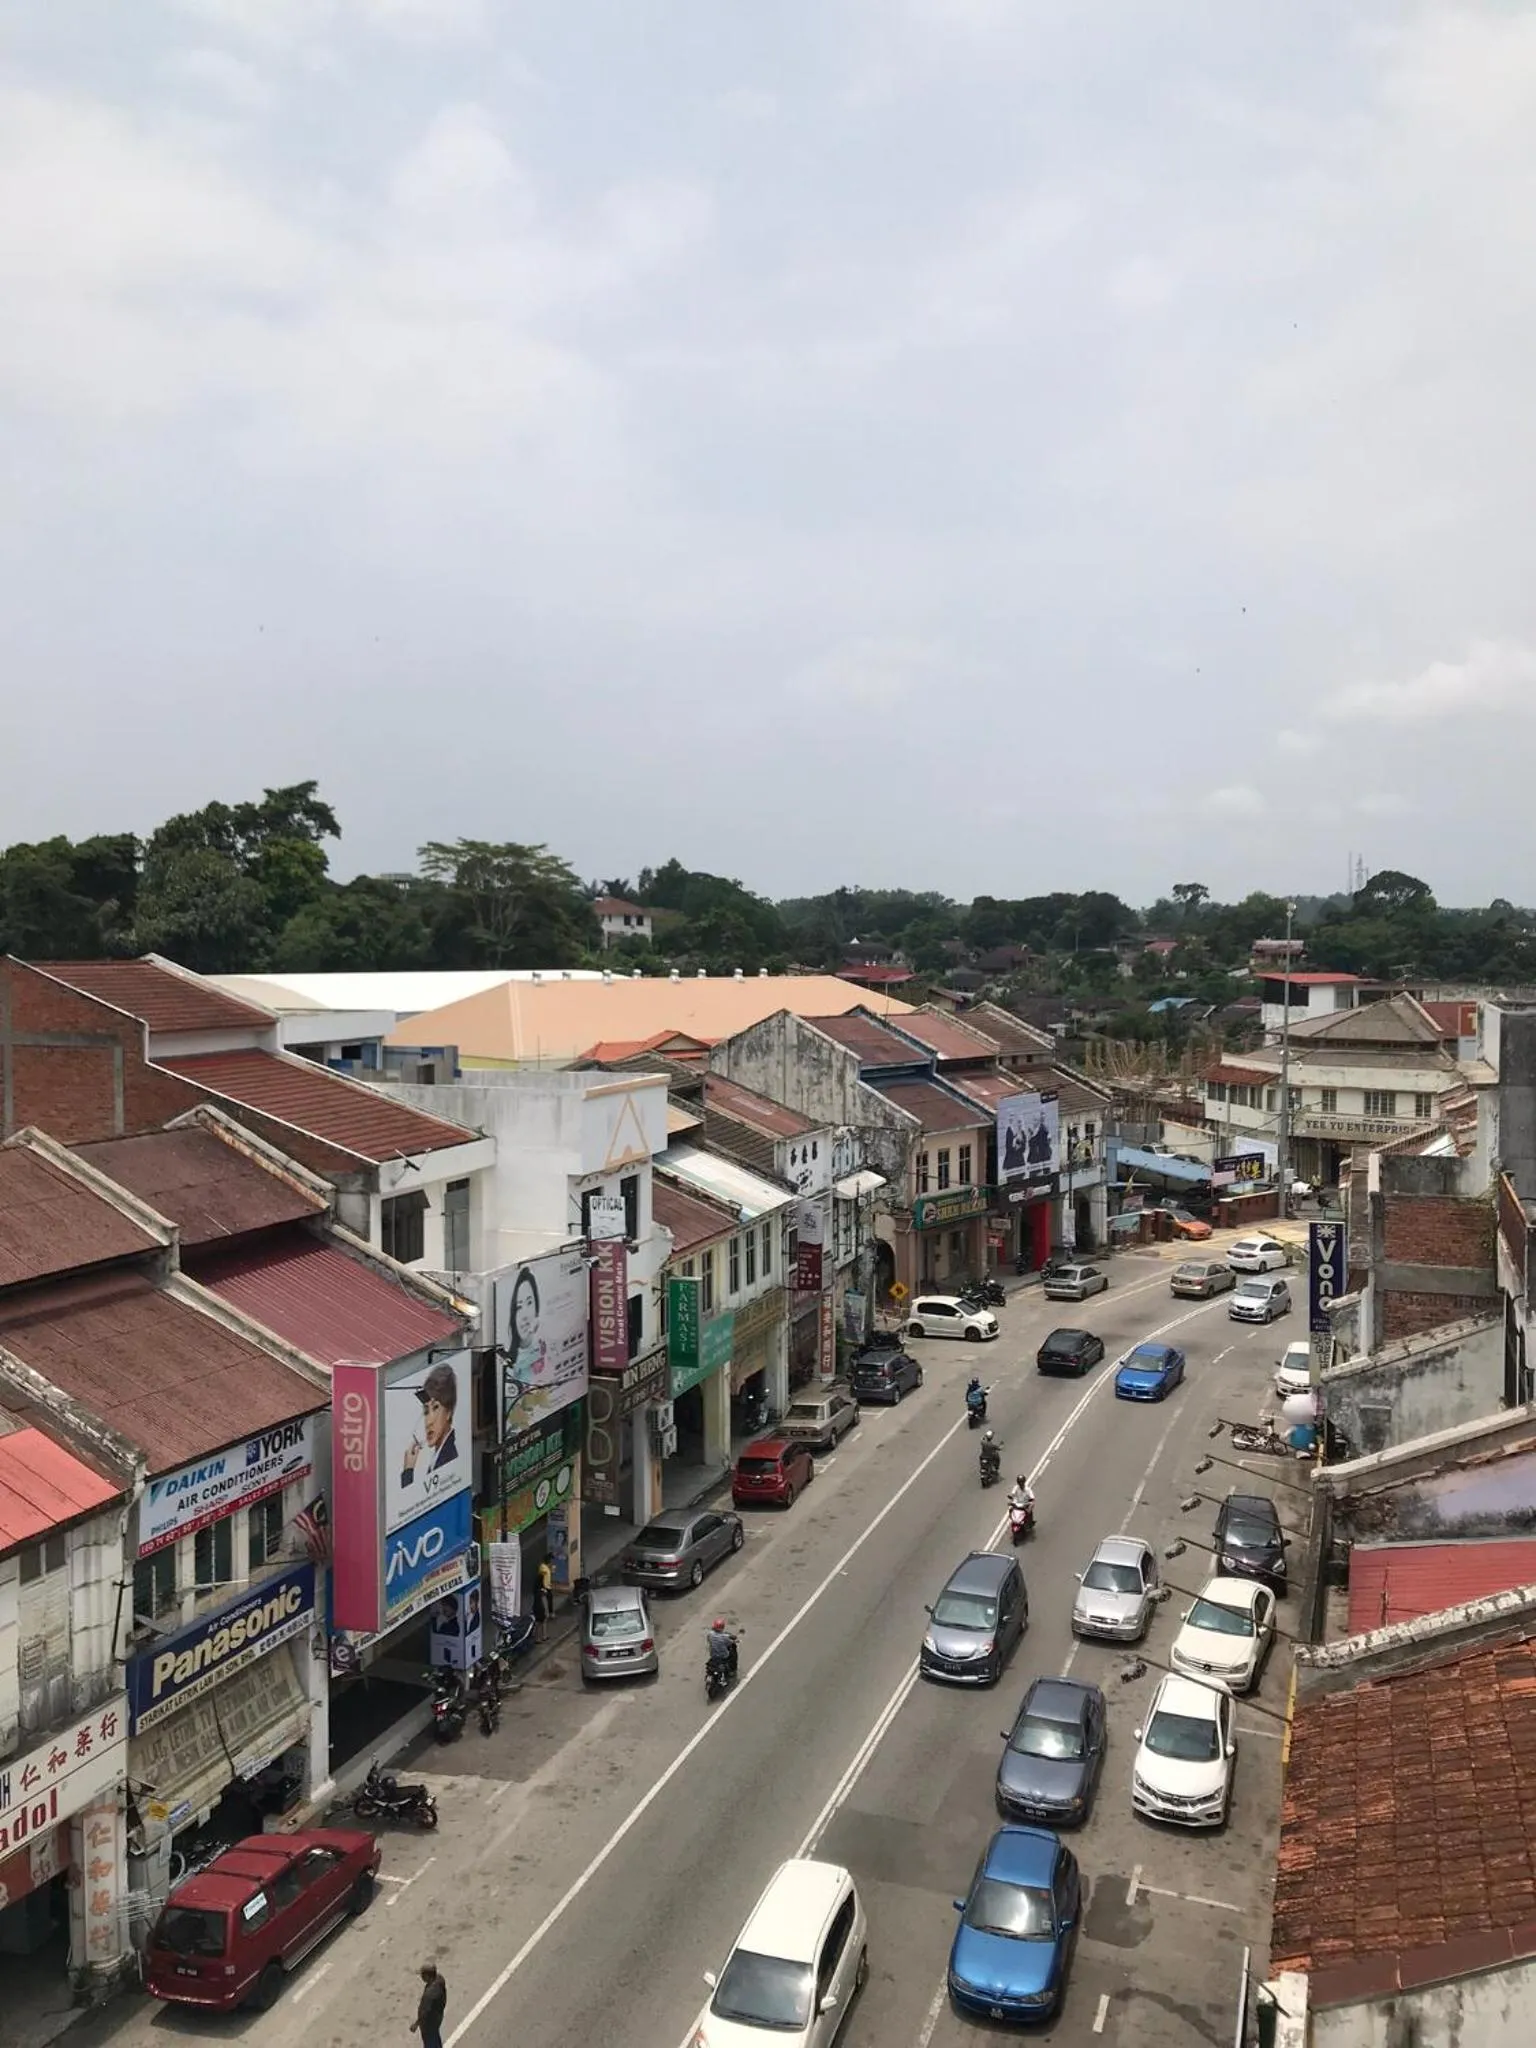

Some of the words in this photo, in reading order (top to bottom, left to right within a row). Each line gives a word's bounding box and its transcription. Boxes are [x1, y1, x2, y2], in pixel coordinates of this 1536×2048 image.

[1331, 1121, 1345, 1131] YU
[591, 1196, 624, 1211] OPTICAL
[1316, 1239, 1337, 1312] Vono
[599, 1280, 616, 1350] VISION
[679, 1282, 690, 1352] FARMASI
[262, 1420, 305, 1458] YORK
[340, 1391, 364, 1473] astro
[165, 1459, 226, 1498] DAIKIN
[177, 1493, 199, 1512] AIR
[202, 1455, 284, 1500] CONDITIONERS
[241, 1475, 269, 1494] SONY
[152, 1583, 302, 1698] Panasonic
